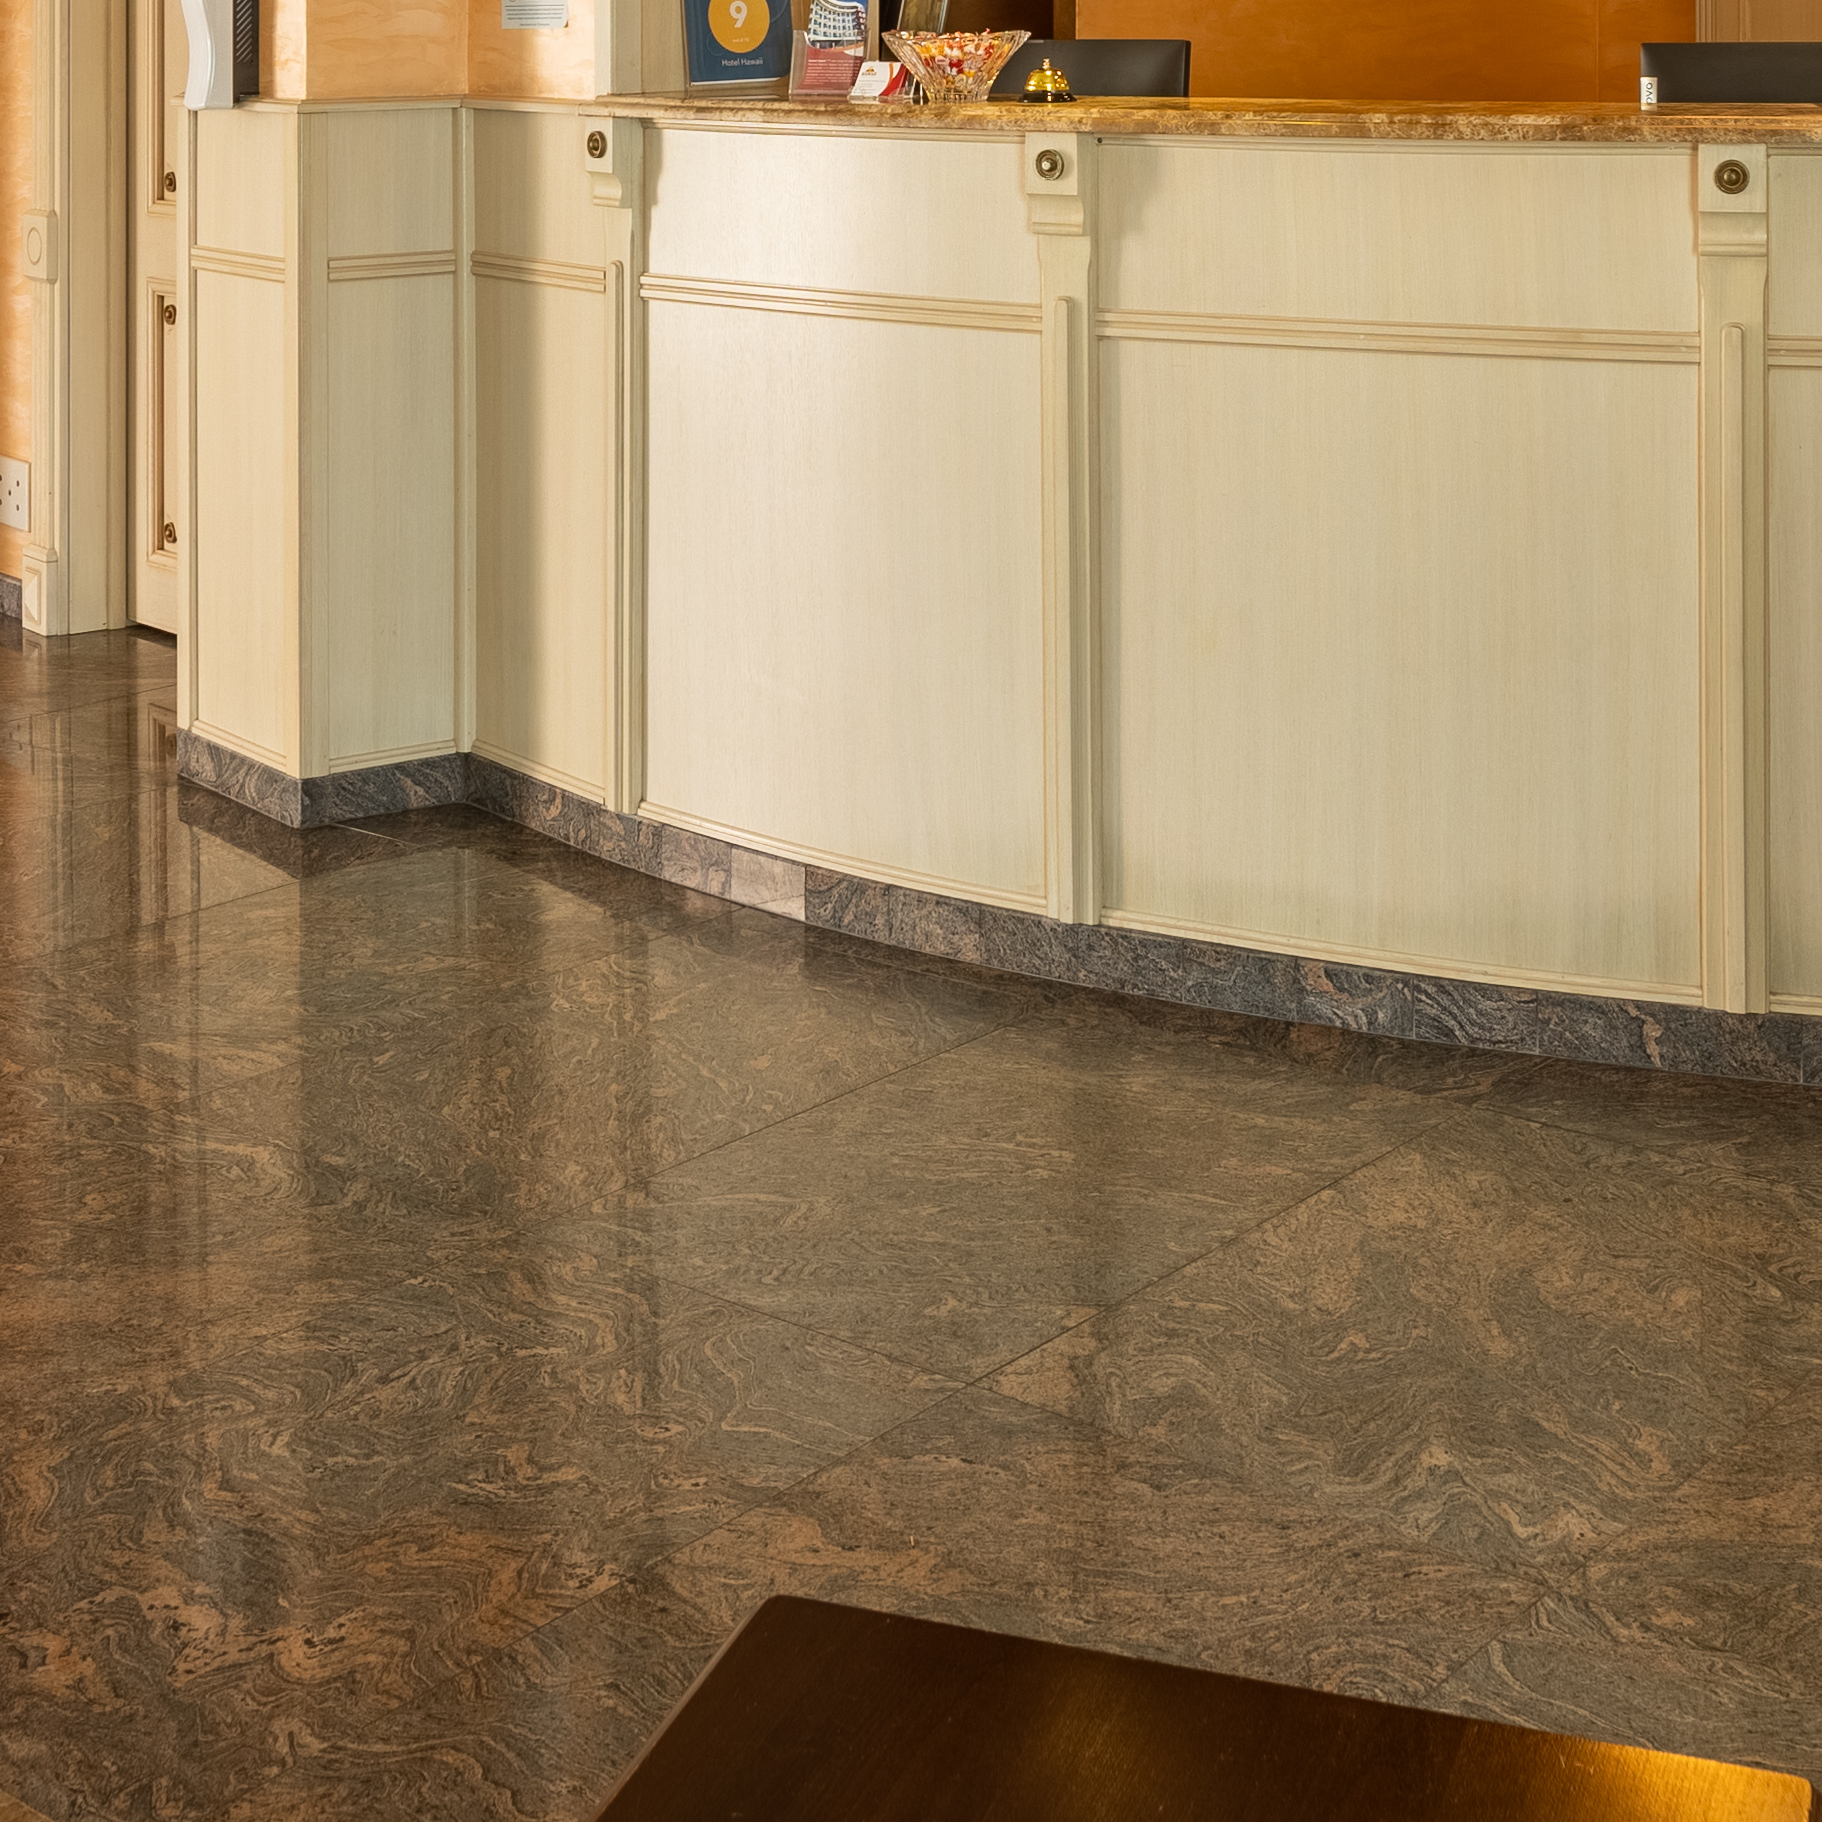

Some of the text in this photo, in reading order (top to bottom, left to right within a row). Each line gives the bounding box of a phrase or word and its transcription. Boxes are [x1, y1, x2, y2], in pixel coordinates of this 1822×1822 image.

[729, 0, 748, 28] 9
[721, 57, 763, 66] Hotel Hawaii
